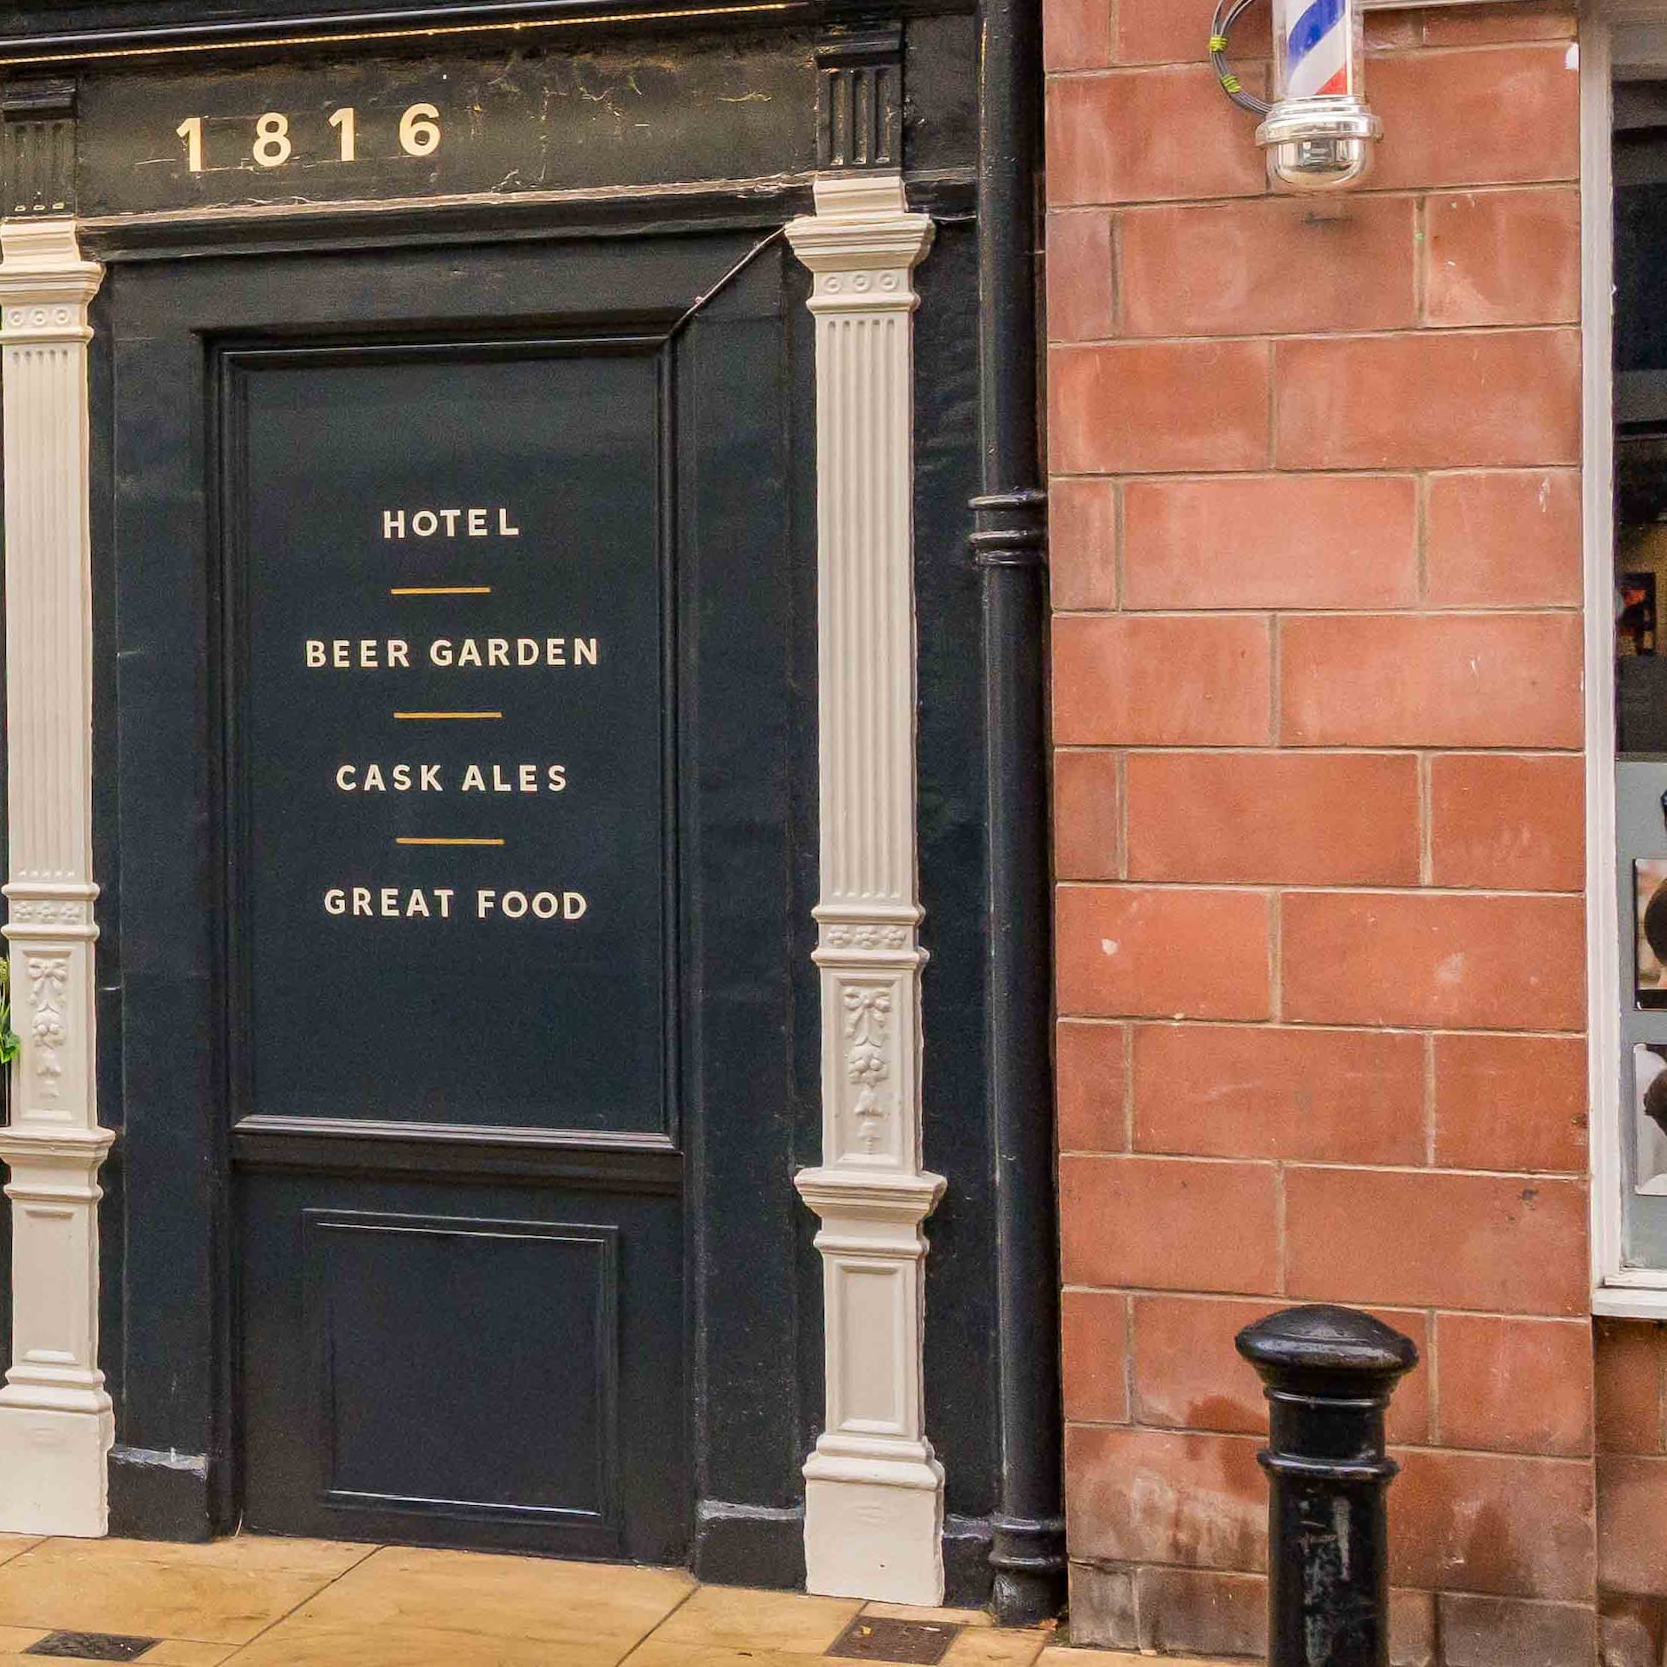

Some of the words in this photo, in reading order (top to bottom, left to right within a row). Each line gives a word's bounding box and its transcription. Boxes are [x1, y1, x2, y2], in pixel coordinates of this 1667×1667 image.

[175, 102, 442, 174] 1816
[382, 508, 520, 539] HOTEL
[305, 639, 411, 669] BEER
[429, 637, 599, 668] GARDEN
[335, 764, 444, 792] CASK
[461, 764, 567, 792] ALES
[323, 887, 454, 918] GREAT
[477, 889, 588, 920] FOOD
